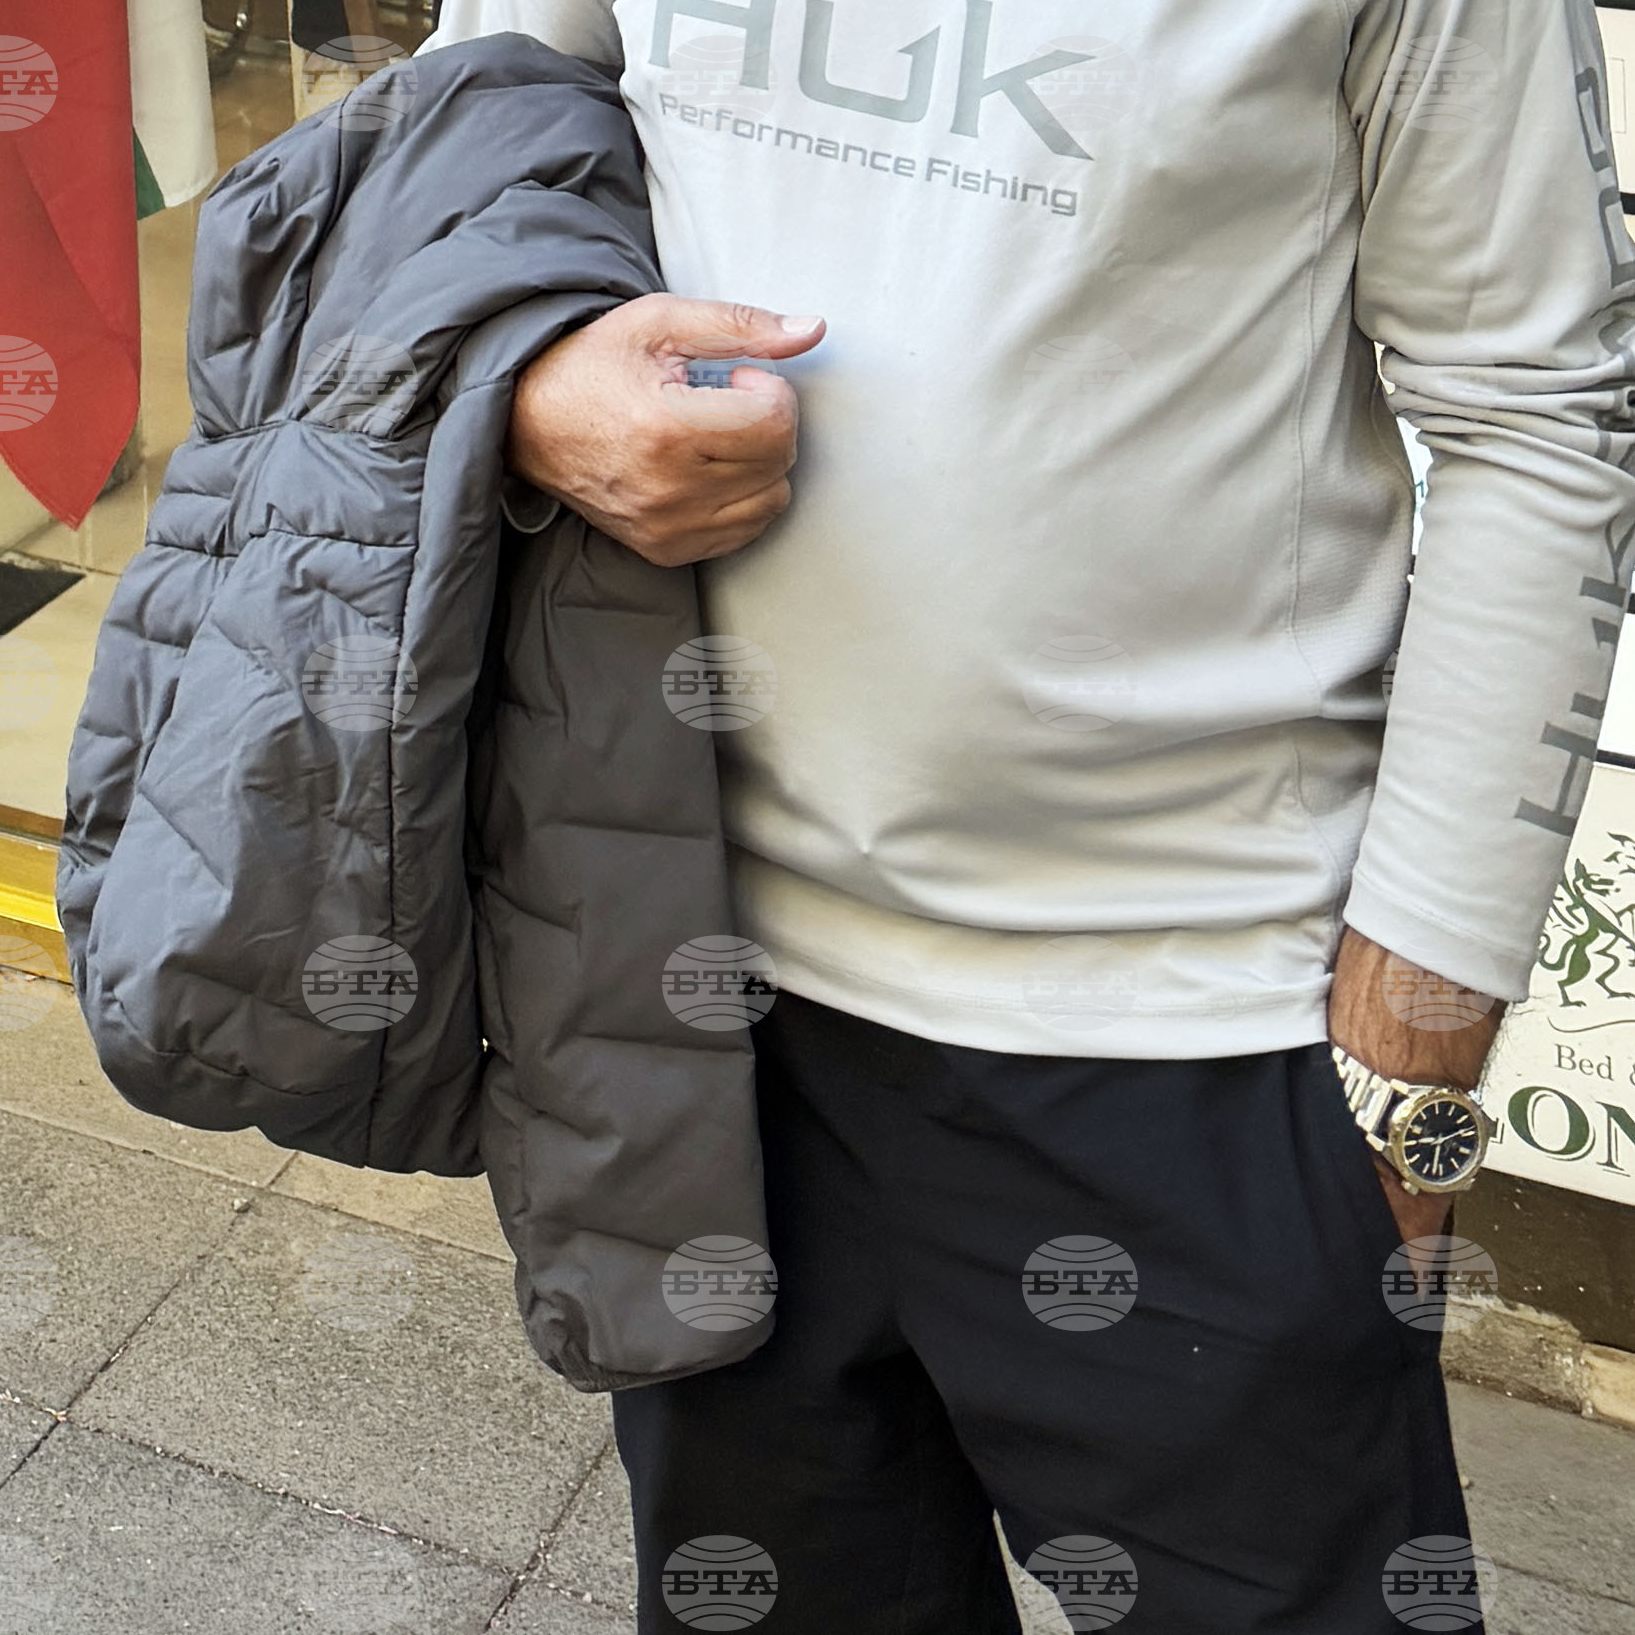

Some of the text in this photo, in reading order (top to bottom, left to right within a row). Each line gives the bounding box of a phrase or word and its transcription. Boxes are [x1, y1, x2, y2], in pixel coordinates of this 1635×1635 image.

[659, 93, 1078, 218] Performance Fishing
[1555, 1043, 1614, 1081] Bed
